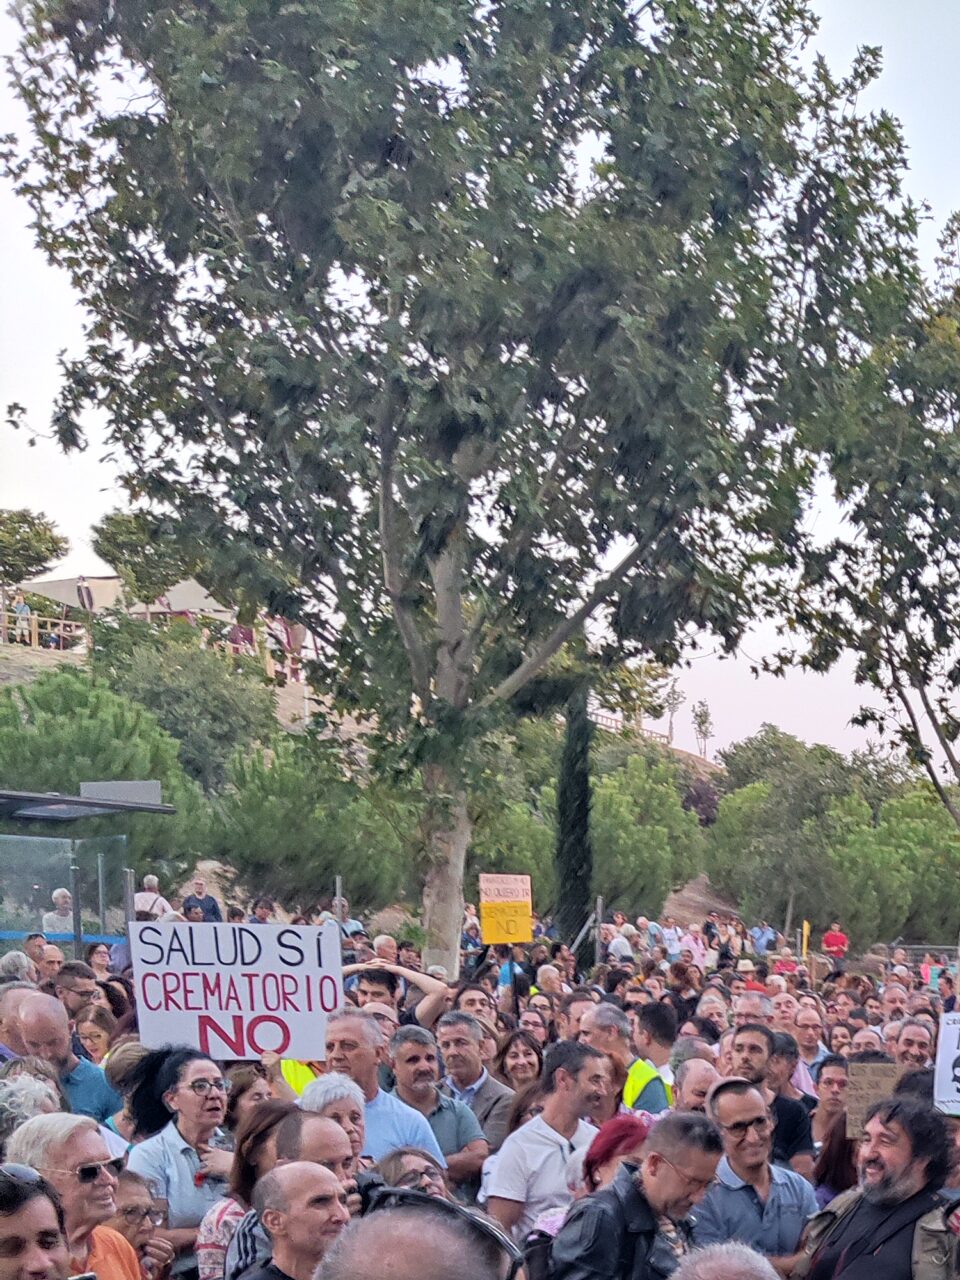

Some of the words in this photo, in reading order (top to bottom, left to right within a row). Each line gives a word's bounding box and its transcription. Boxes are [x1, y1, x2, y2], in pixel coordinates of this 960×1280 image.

[138, 926, 262, 966] SALUD
[497, 919, 518, 935] NO
[141, 972, 338, 1012] CREMATORIO
[198, 1014, 291, 1057] NO
